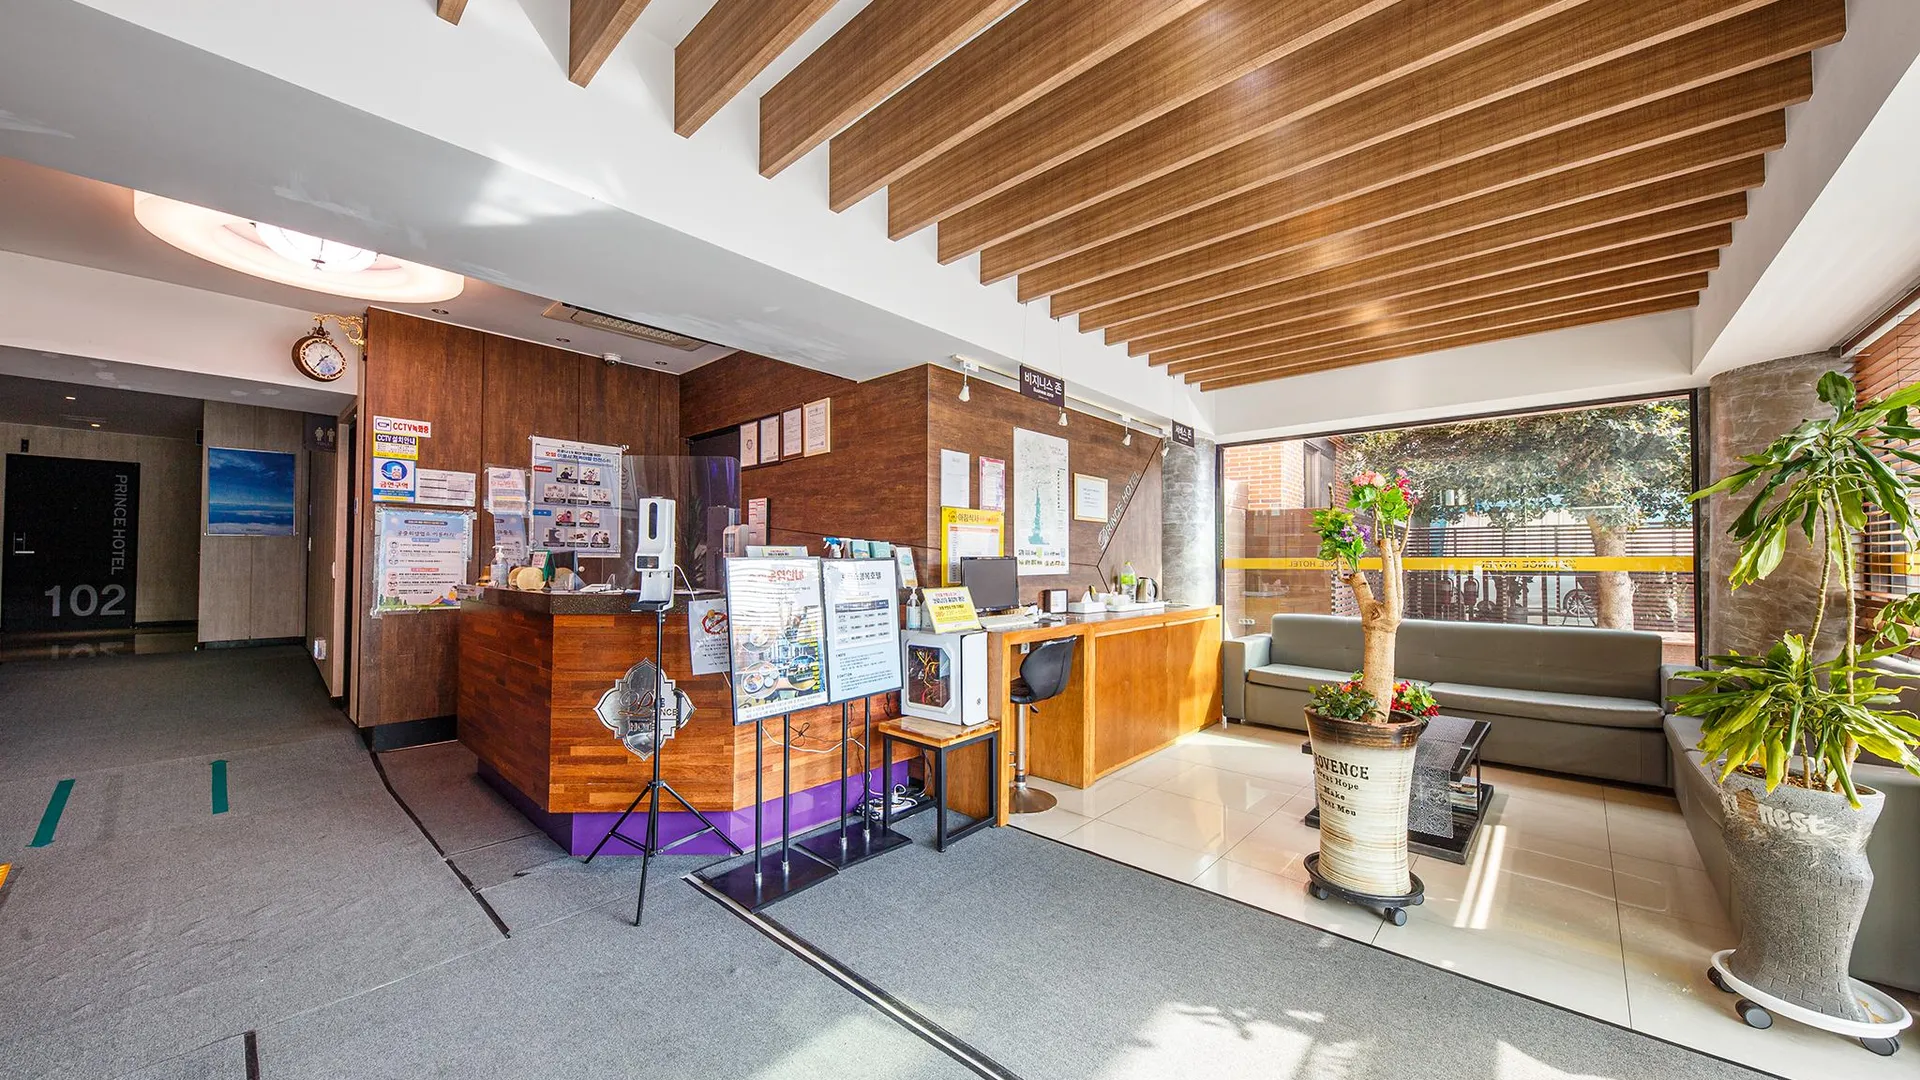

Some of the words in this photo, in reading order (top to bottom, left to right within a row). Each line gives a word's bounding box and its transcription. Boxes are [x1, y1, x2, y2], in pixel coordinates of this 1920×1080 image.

[1024, 371, 1054, 391] 비지니스
[1054, 381, 1063, 396] 존
[113, 474, 129, 527] PRINCE
[1121, 470, 1140, 504] HOTEL
[110, 529, 126, 575] HOTEL
[44, 583, 127, 617] 102
[1322, 785, 1346, 801] Make
[1334, 777, 1359, 790] Hope
[1336, 804, 1357, 816] Men
